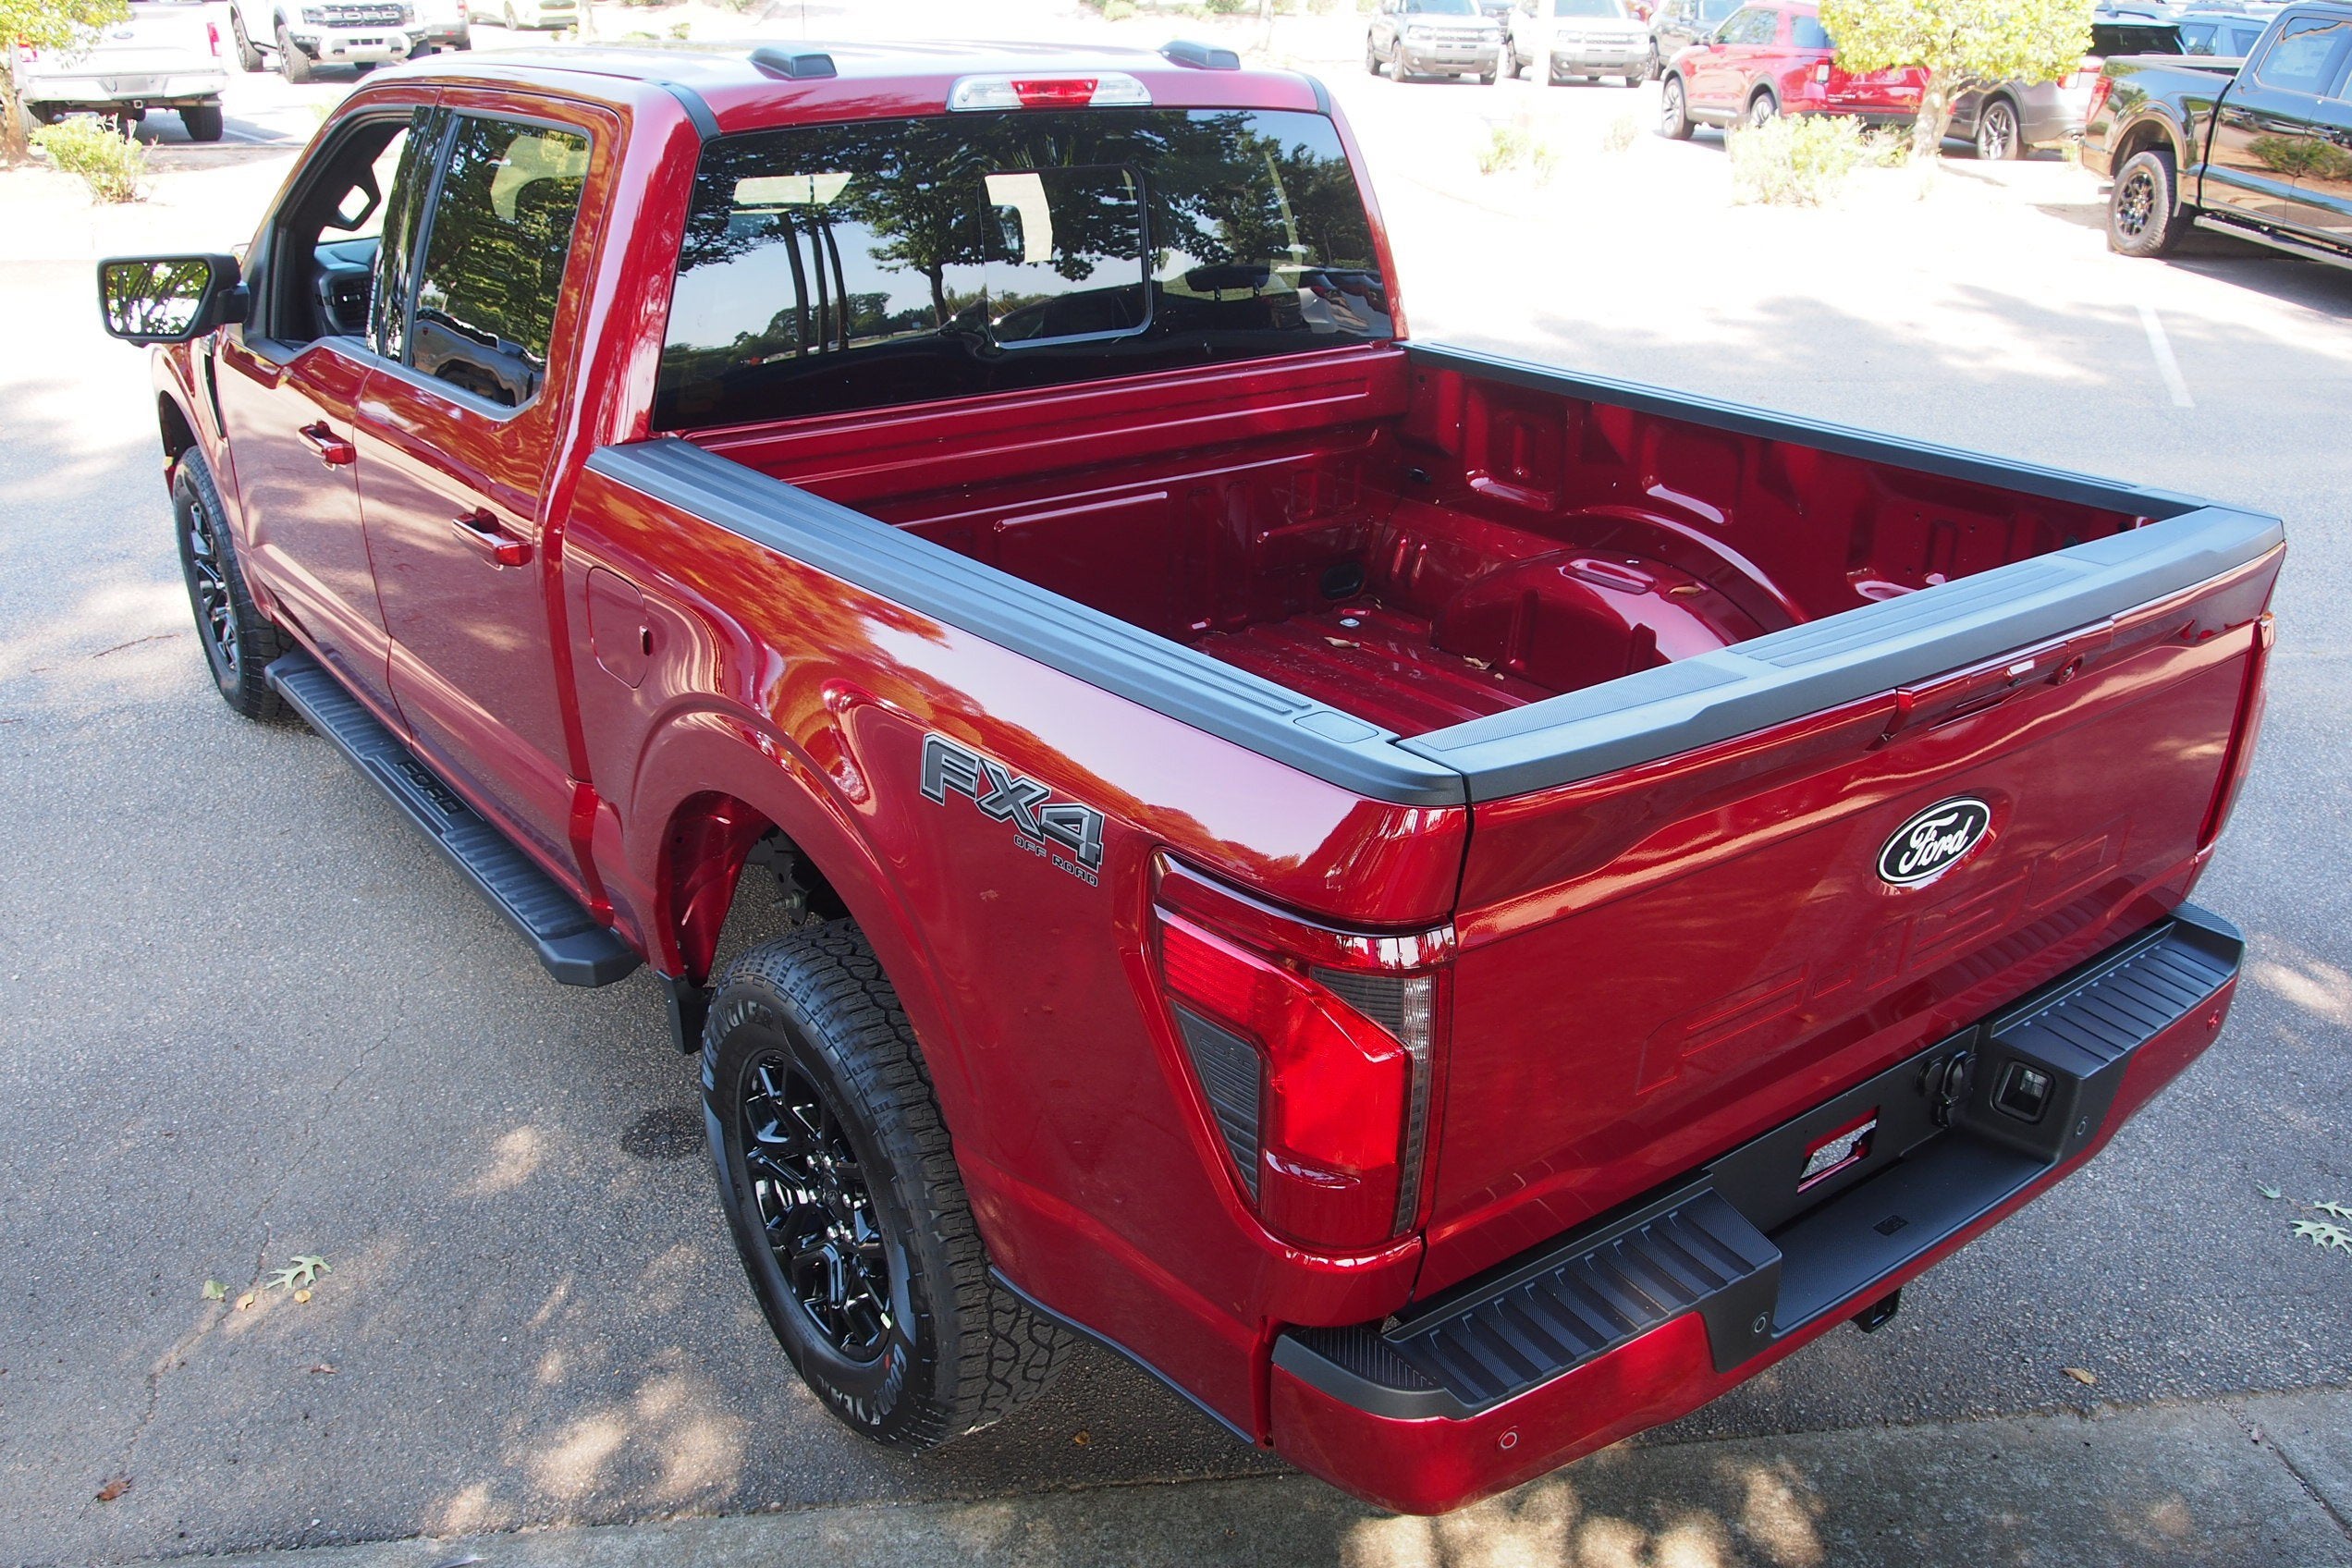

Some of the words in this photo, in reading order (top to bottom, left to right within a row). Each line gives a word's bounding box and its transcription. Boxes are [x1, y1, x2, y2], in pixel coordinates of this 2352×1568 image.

[324, 10, 400, 20] FORD
[394, 762, 465, 815] FORD
[920, 731, 1105, 873] FX4
[1013, 834, 1047, 858] OFF
[1052, 853, 1098, 888] ROAD
[1898, 812, 1974, 875] Ford
